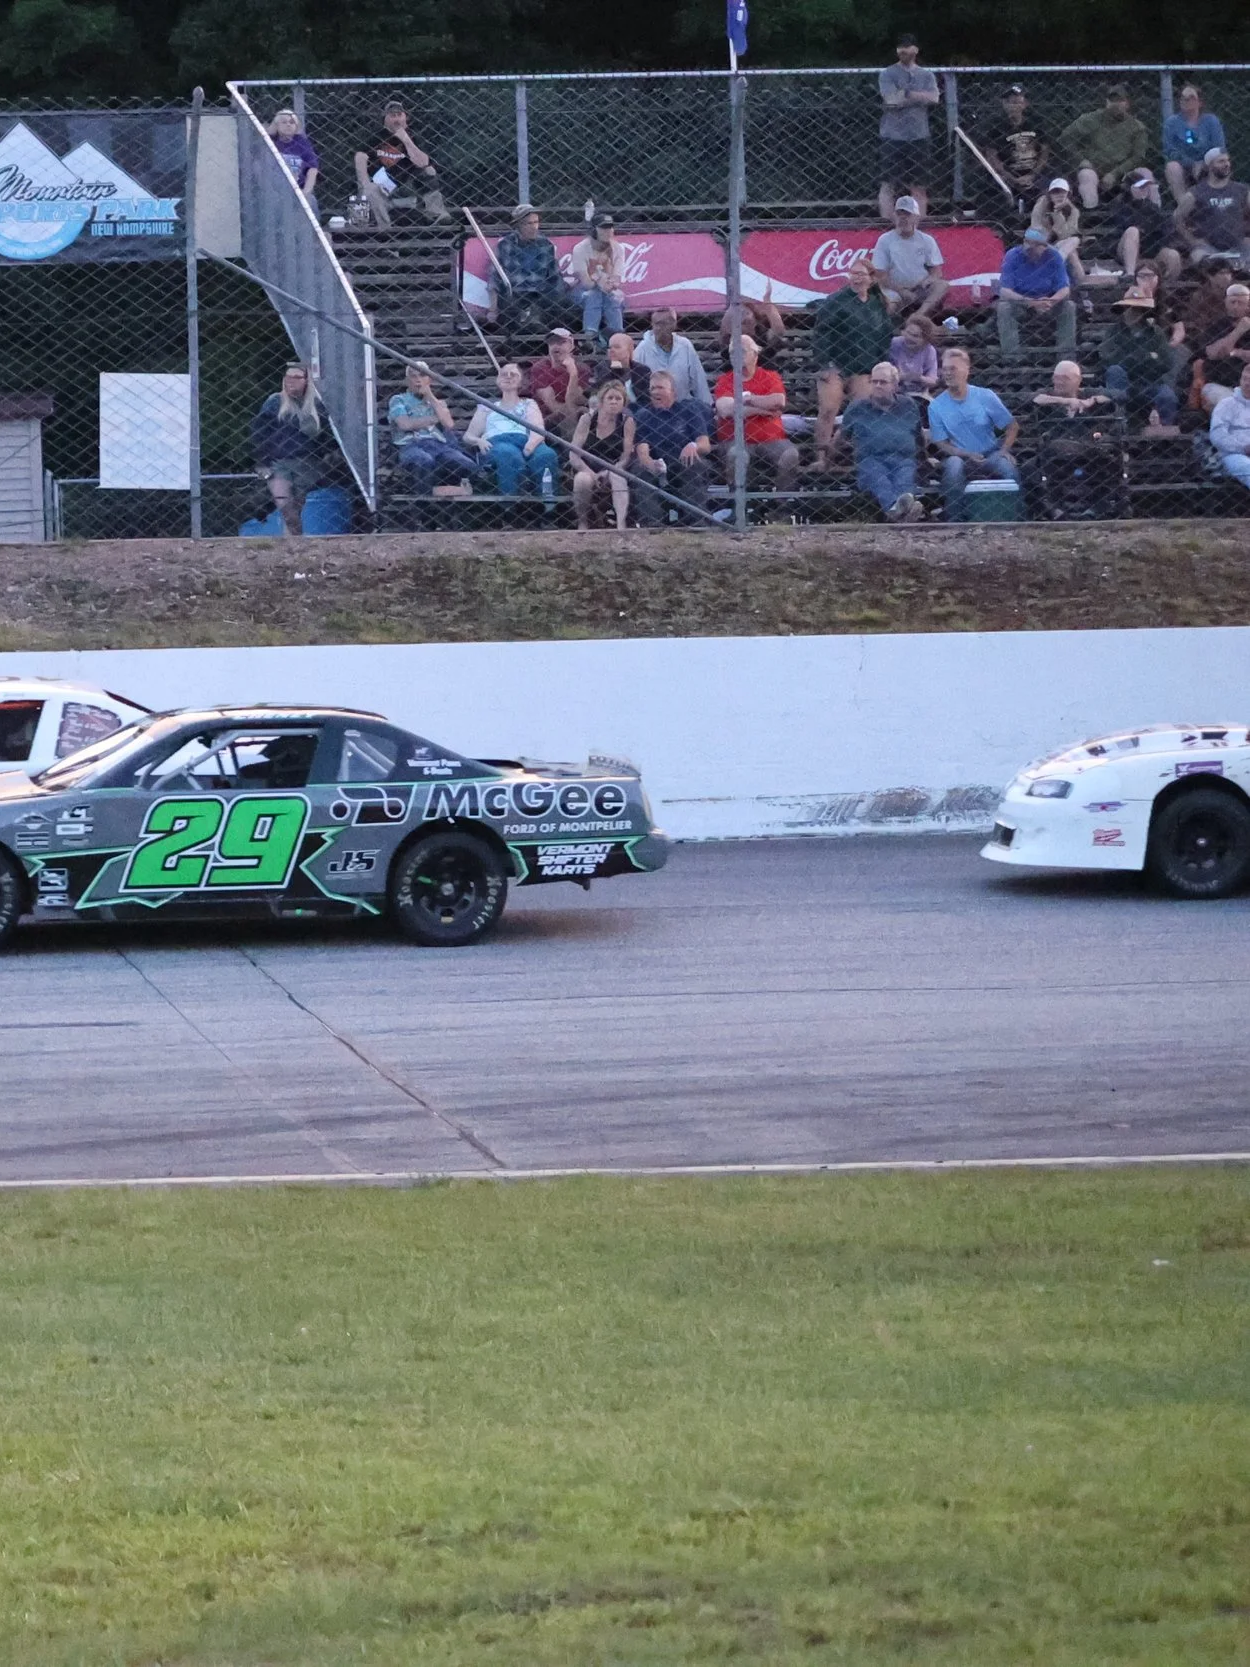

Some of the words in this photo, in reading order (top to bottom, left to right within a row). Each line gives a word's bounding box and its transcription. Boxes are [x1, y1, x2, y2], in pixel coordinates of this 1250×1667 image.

[93, 197, 182, 221] PARK
[91, 223, 114, 236] NEW
[116, 222, 175, 235] HAMPSHIRE
[422, 782, 626, 820] McGee
[503, 824, 537, 834] FORD
[539, 823, 557, 833] OF
[559, 820, 632, 832] MONTPELIER
[118, 793, 311, 893] 29
[536, 843, 615, 856] VERMONT
[536, 854, 607, 865] SHIFTER
[541, 864, 596, 875] KARTS
